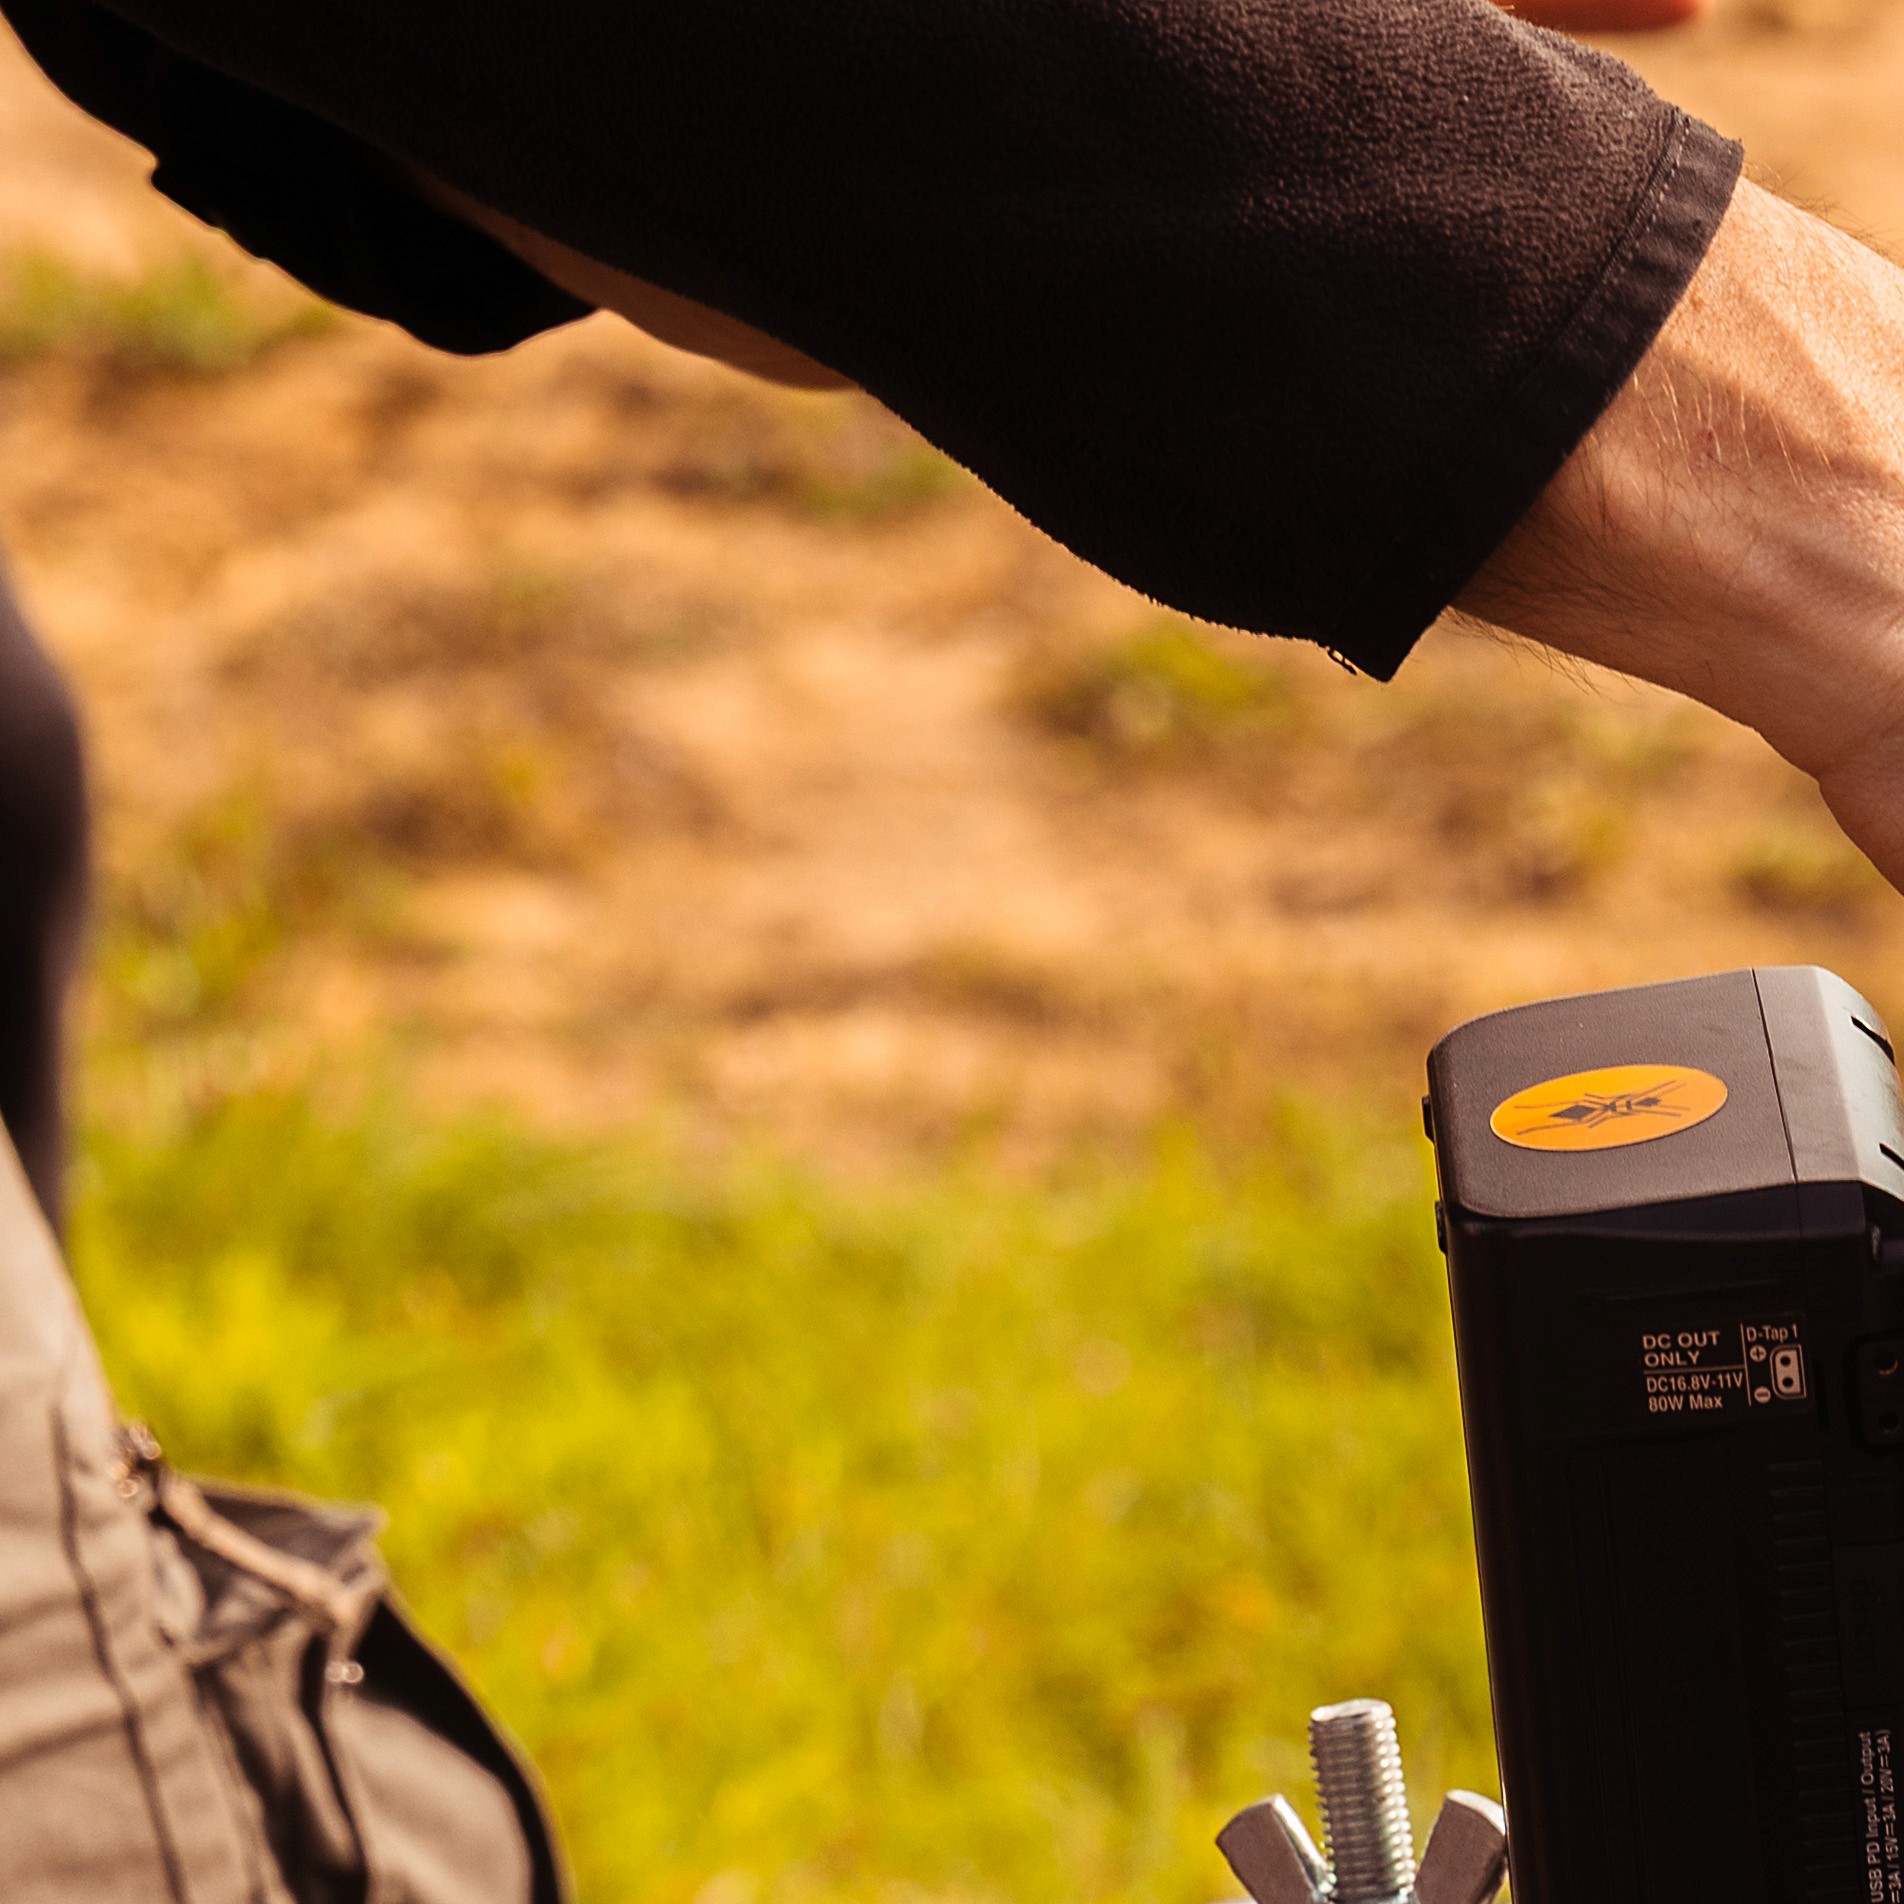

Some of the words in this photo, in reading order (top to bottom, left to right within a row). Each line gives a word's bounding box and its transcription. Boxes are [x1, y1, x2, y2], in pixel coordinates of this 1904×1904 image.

[1642, 1334, 1671, 1350] DC
[1677, 1330, 1720, 1348] OUT
[1746, 1325, 1788, 1343] D-Tap
[1792, 1323, 1798, 1339] 1
[1644, 1350, 1700, 1368] ONLY
[1646, 1371, 1743, 1393] DC16.8V-11V
[1649, 1394, 1683, 1413] 80W
[1689, 1395, 1723, 1410] Max
[1858, 1730, 1876, 1785] Output
[1863, 1797, 1881, 1838] Input
[1865, 1842, 1883, 1863] PD
[1868, 1868, 1885, 1903] USB
